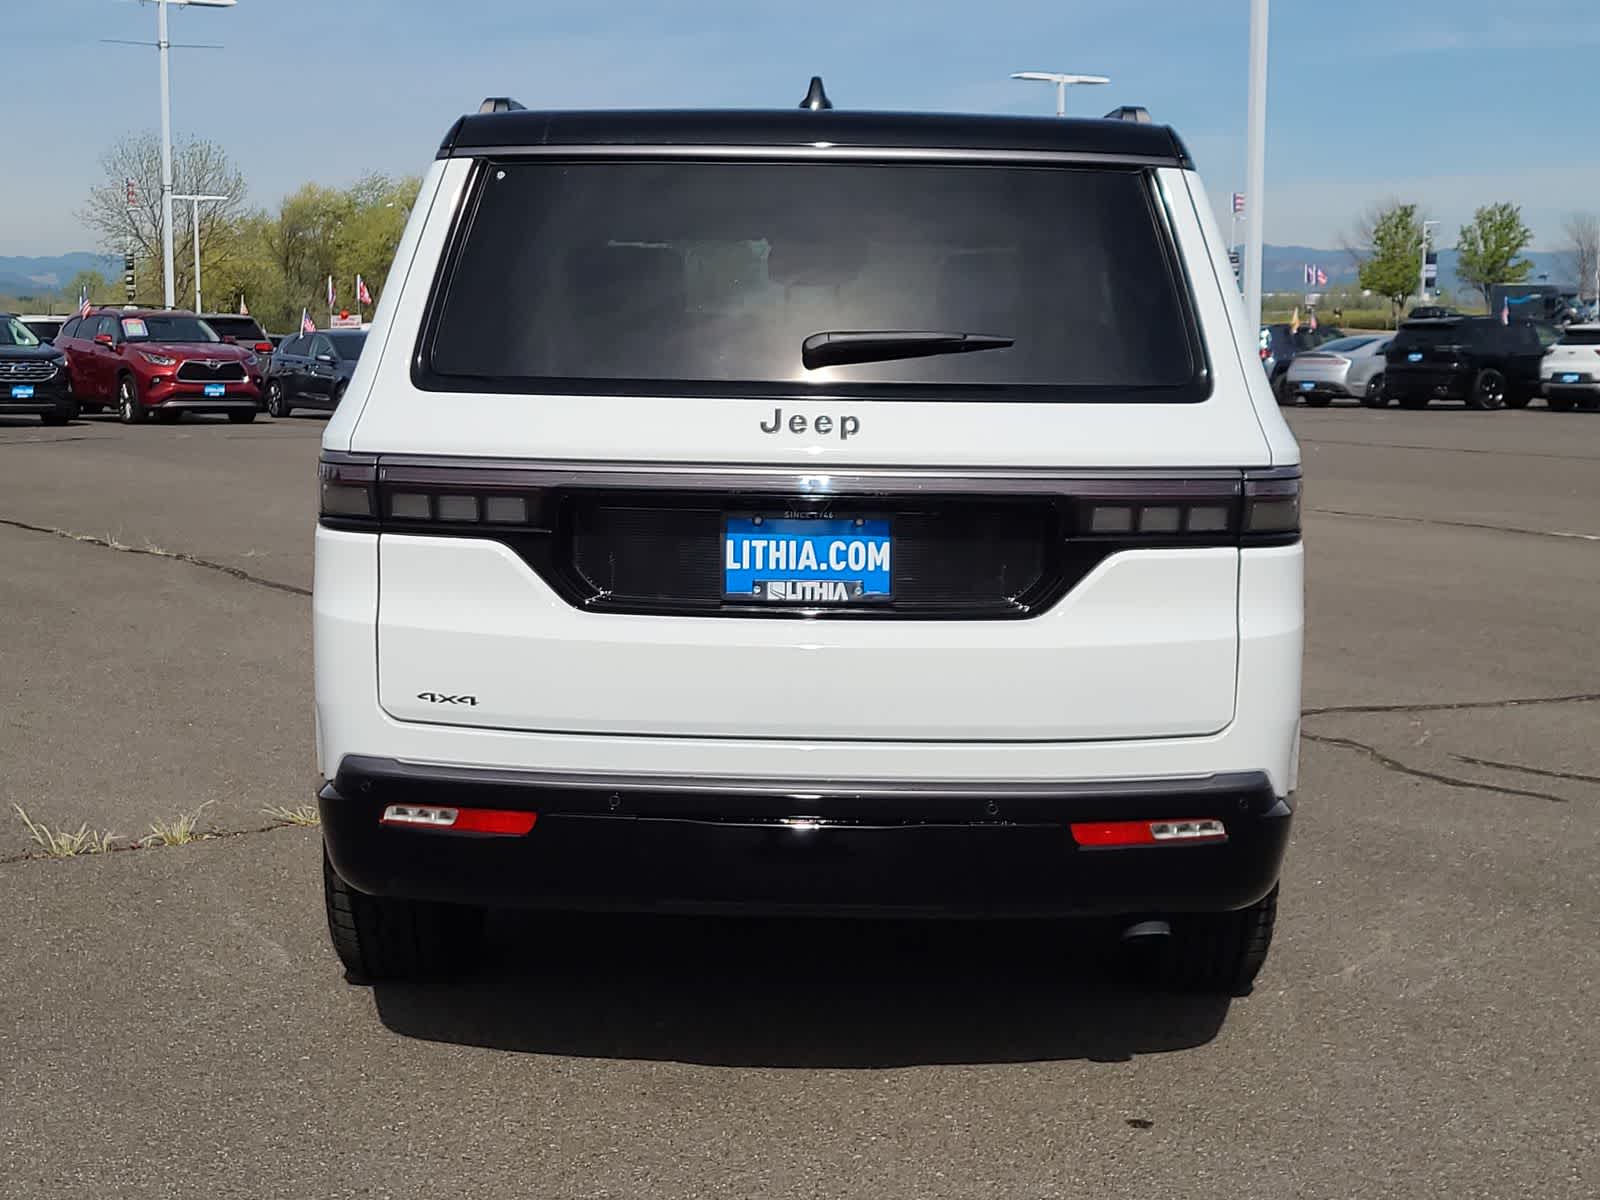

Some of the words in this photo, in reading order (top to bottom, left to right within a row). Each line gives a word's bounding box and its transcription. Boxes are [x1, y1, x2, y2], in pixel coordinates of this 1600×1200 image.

[760, 408, 860, 440] Jeep
[726, 539, 890, 571] LITHIA.COM
[786, 581, 849, 600] LITHIA
